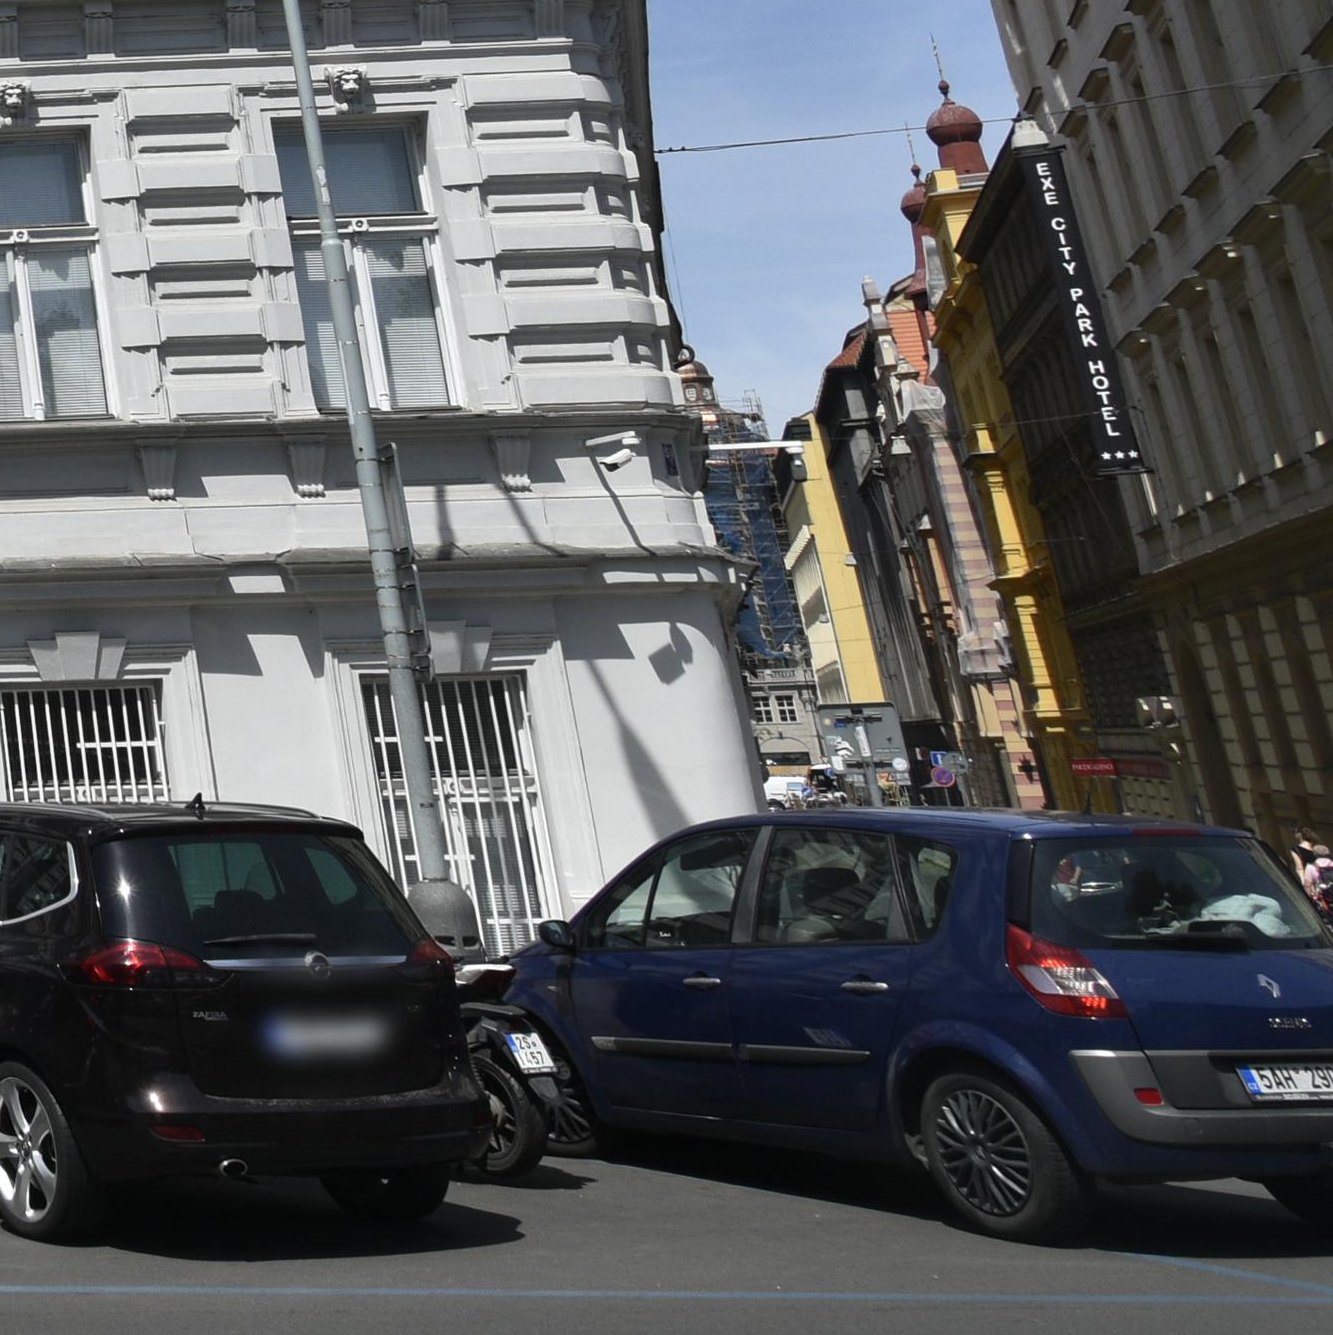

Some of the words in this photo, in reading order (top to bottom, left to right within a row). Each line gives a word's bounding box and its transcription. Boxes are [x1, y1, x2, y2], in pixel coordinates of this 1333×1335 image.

[1036, 162, 1059, 205] EXE
[1051, 217, 1076, 275] CITY
[1070, 288, 1098, 347] PARK
[1088, 360, 1121, 437] HOTEL
[515, 1036, 531, 1050] 2S
[1255, 1066, 1298, 1090] 5AH
